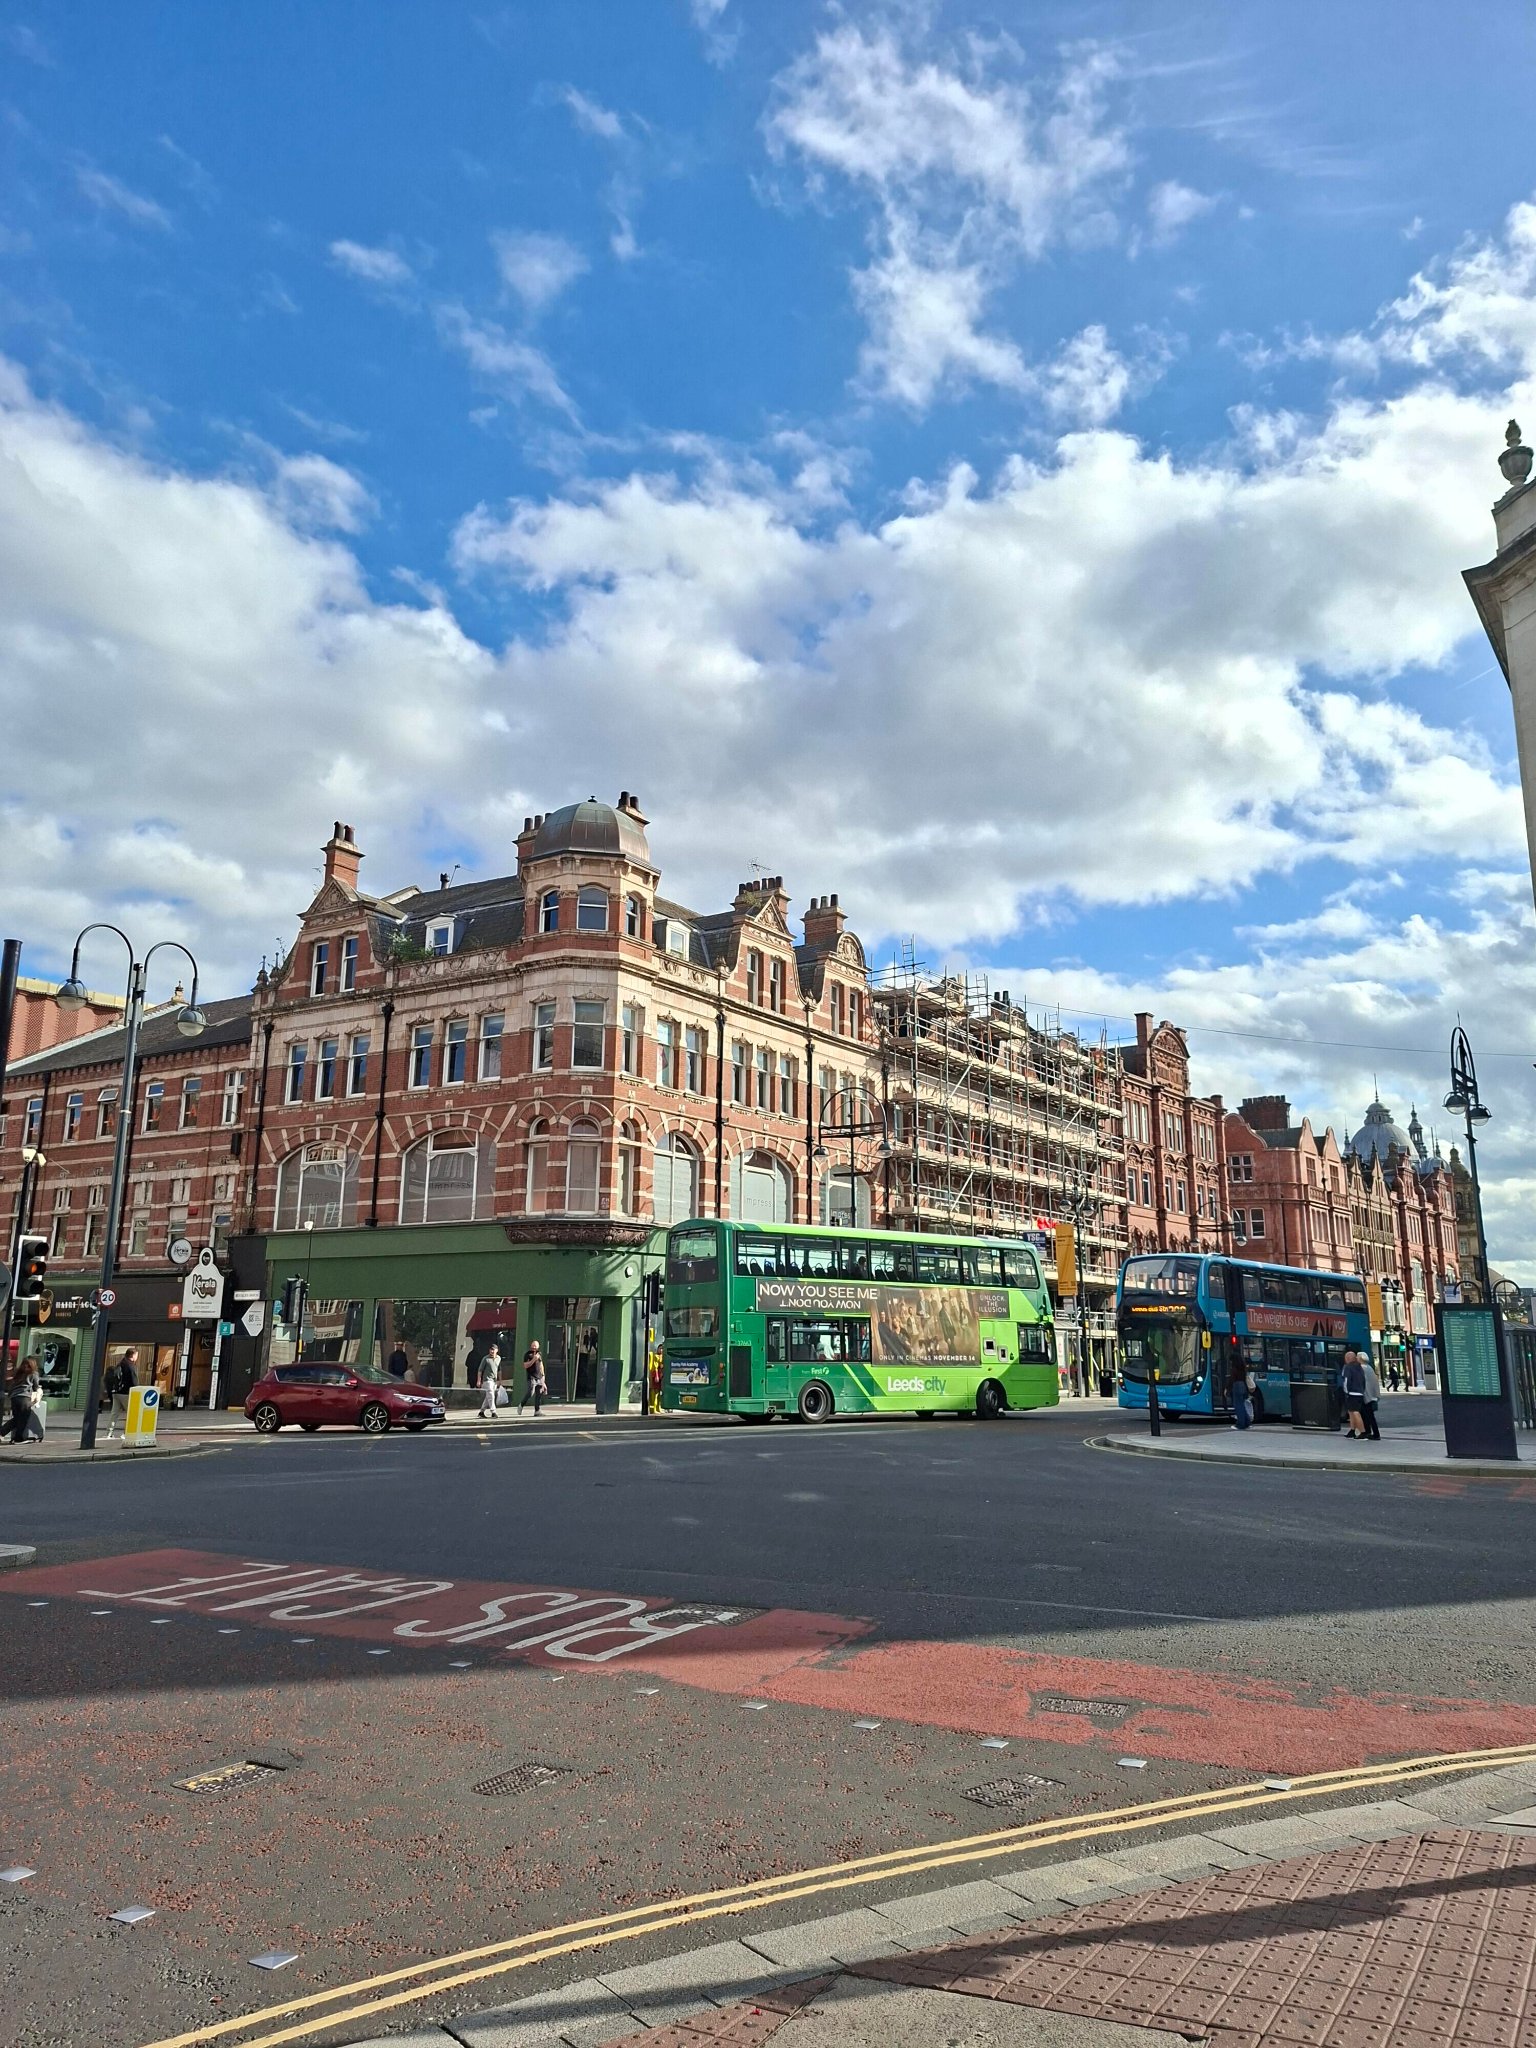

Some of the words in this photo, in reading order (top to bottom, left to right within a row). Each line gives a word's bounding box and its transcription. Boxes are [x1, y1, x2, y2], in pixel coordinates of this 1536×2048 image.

[102, 1294, 114, 1302] 20
[760, 1283, 795, 1296] NOW
[797, 1286, 826, 1298] YOU
[828, 1287, 855, 1298] SEE
[857, 1288, 878, 1300] ME
[813, 1300, 835, 1308] YOU
[836, 1301, 861, 1309] NOW
[1248, 1308, 1263, 1323] The
[1264, 1311, 1287, 1328] weight
[1288, 1313, 1294, 1327] is
[1295, 1315, 1309, 1328] over
[1333, 1319, 1346, 1333] voy
[811, 1367, 822, 1375] First
[76, 1562, 454, 1620] GATE
[393, 1592, 742, 1662] BUS
